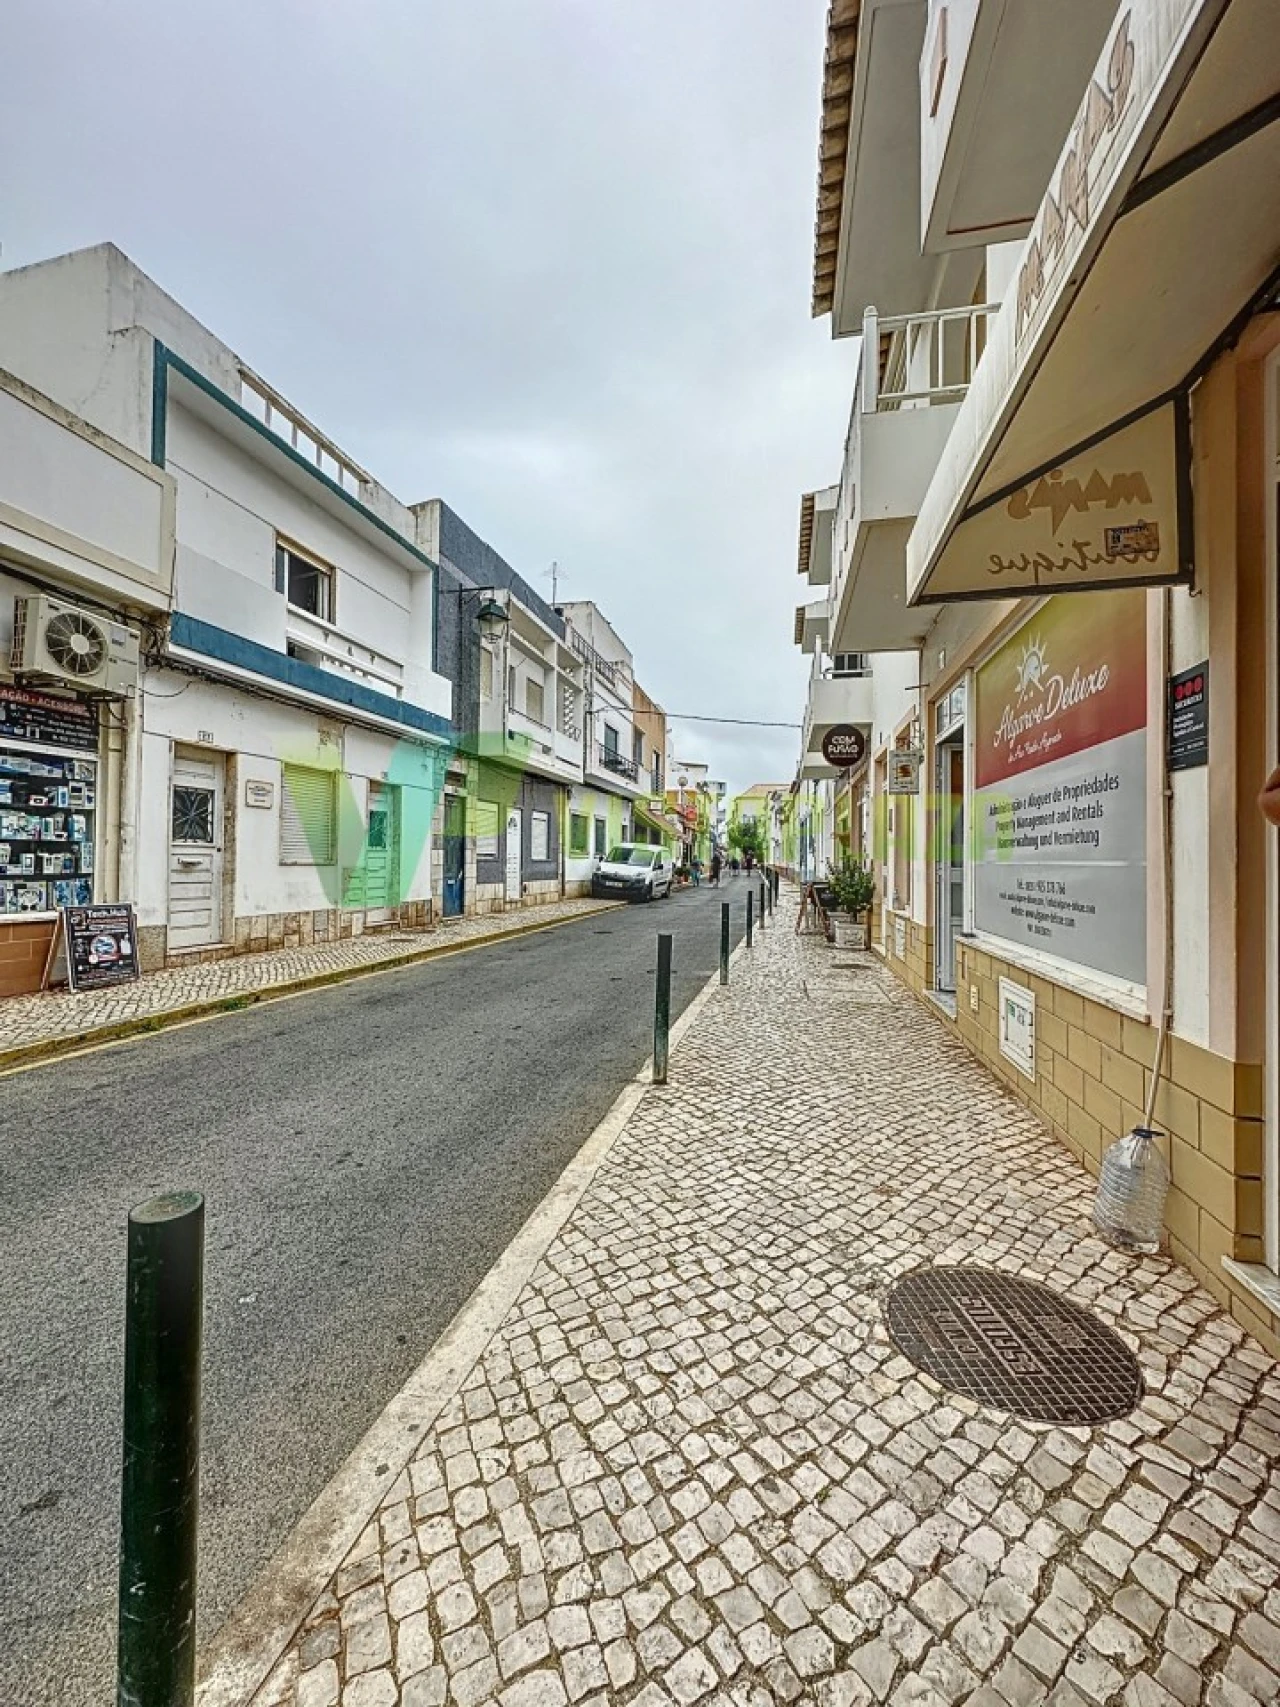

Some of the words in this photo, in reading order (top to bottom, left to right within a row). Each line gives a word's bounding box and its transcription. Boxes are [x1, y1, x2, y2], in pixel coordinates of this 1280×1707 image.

[993, 703, 1045, 748] Algarve
[1043, 665, 1110, 720] Deluxe
[1052, 787, 1062, 803] de
[1063, 773, 1119, 802] Propriedades
[1056, 805, 1070, 823] and
[1072, 800, 1103, 821] Rentals
[957, 1296, 1044, 1375] ESGOTOS
